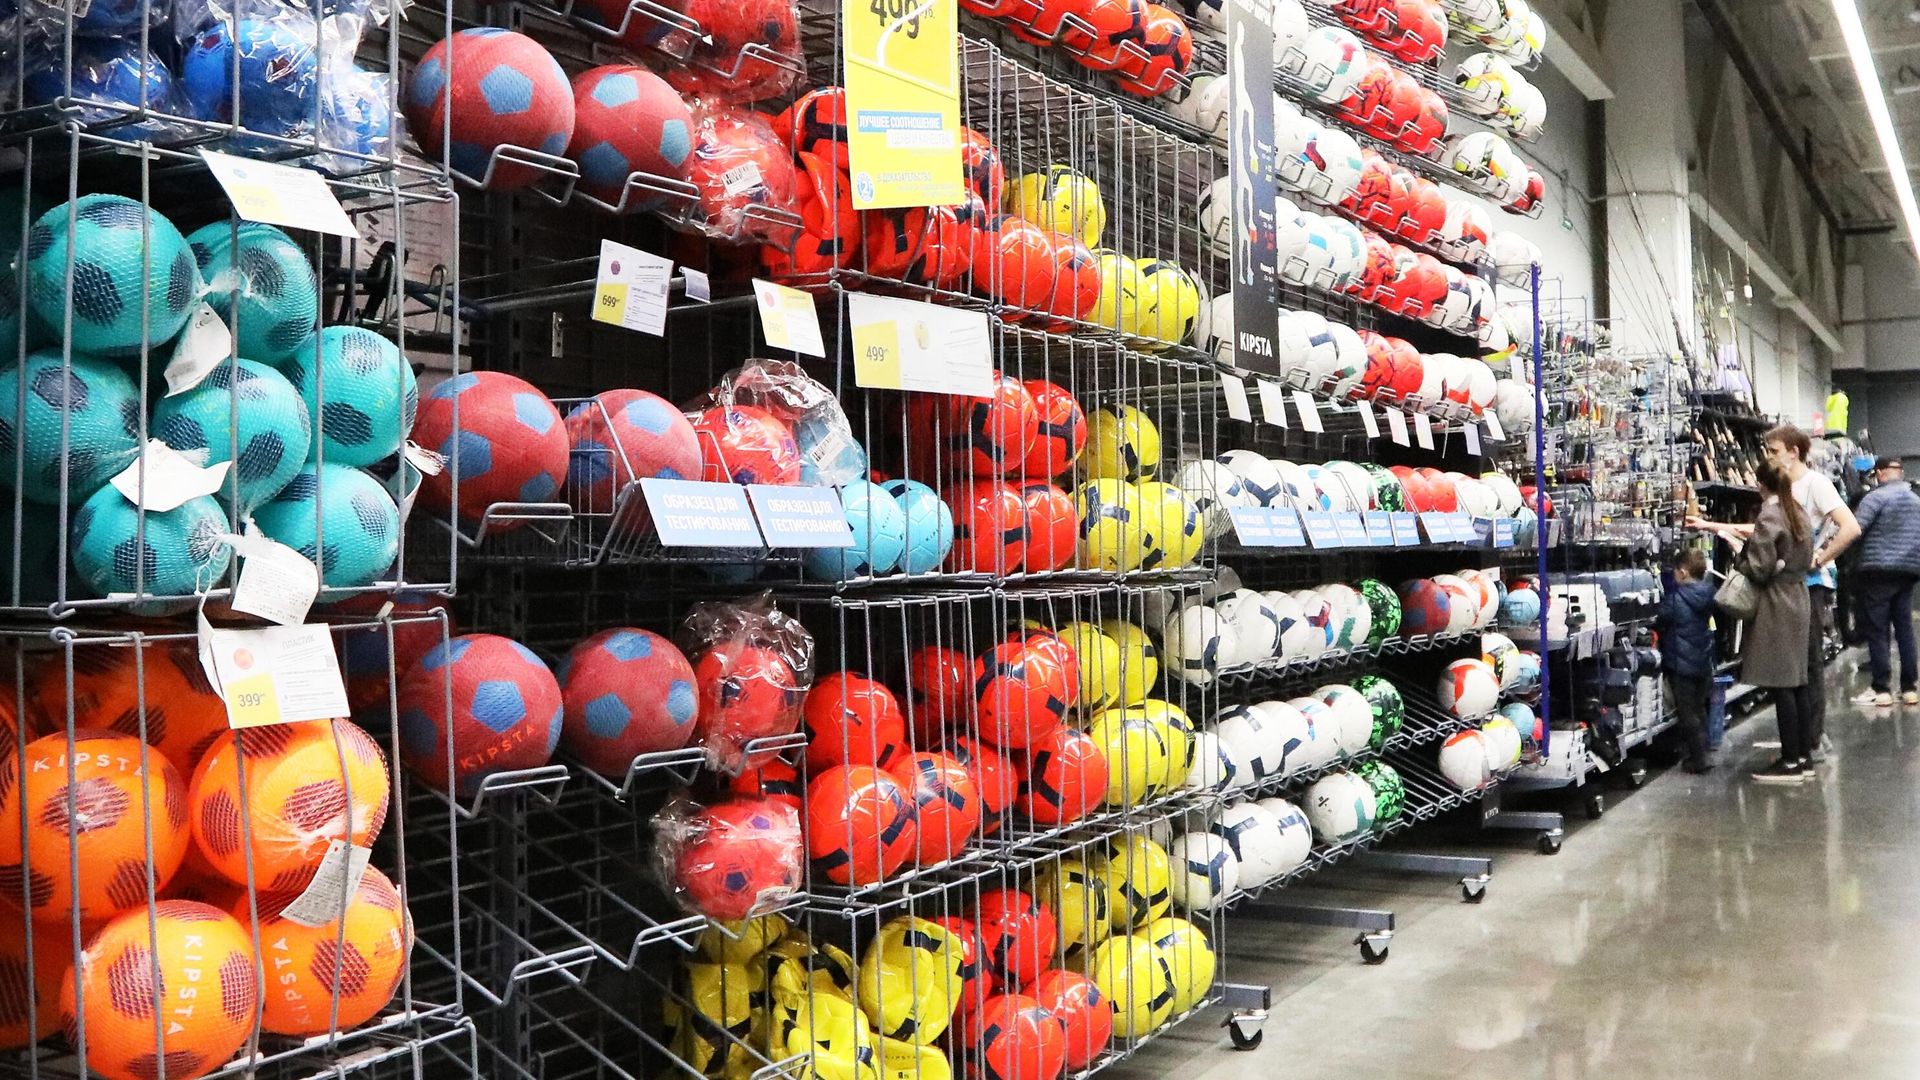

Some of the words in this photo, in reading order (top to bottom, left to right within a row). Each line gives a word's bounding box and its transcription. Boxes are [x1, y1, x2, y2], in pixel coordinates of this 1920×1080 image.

[859, 115, 890, 128] ЛУЧШЕЕ
[890, 116, 941, 129] СООТНОШЕНИЕ
[602, 294, 617, 308] 699
[1240, 331, 1273, 358] KIPSTA
[866, 345, 885, 362] 499
[662, 494, 715, 513] ОБРАЗЕЦ
[715, 496, 739, 513] ДЛЯ
[767, 498, 813, 516] ОБРАЗЕЦ
[812, 501, 834, 516] ДЛЯ
[664, 515, 751, 531] ТЕСТИРОВАНИЯ
[768, 518, 845, 533] ТЕСТИРОВАНИЯ
[238, 692, 261, 708] 399
[461, 723, 536, 769] KIPSTA
[167, 934, 203, 1036] KIPSTA
[272, 937, 312, 1026] KIPSTA
